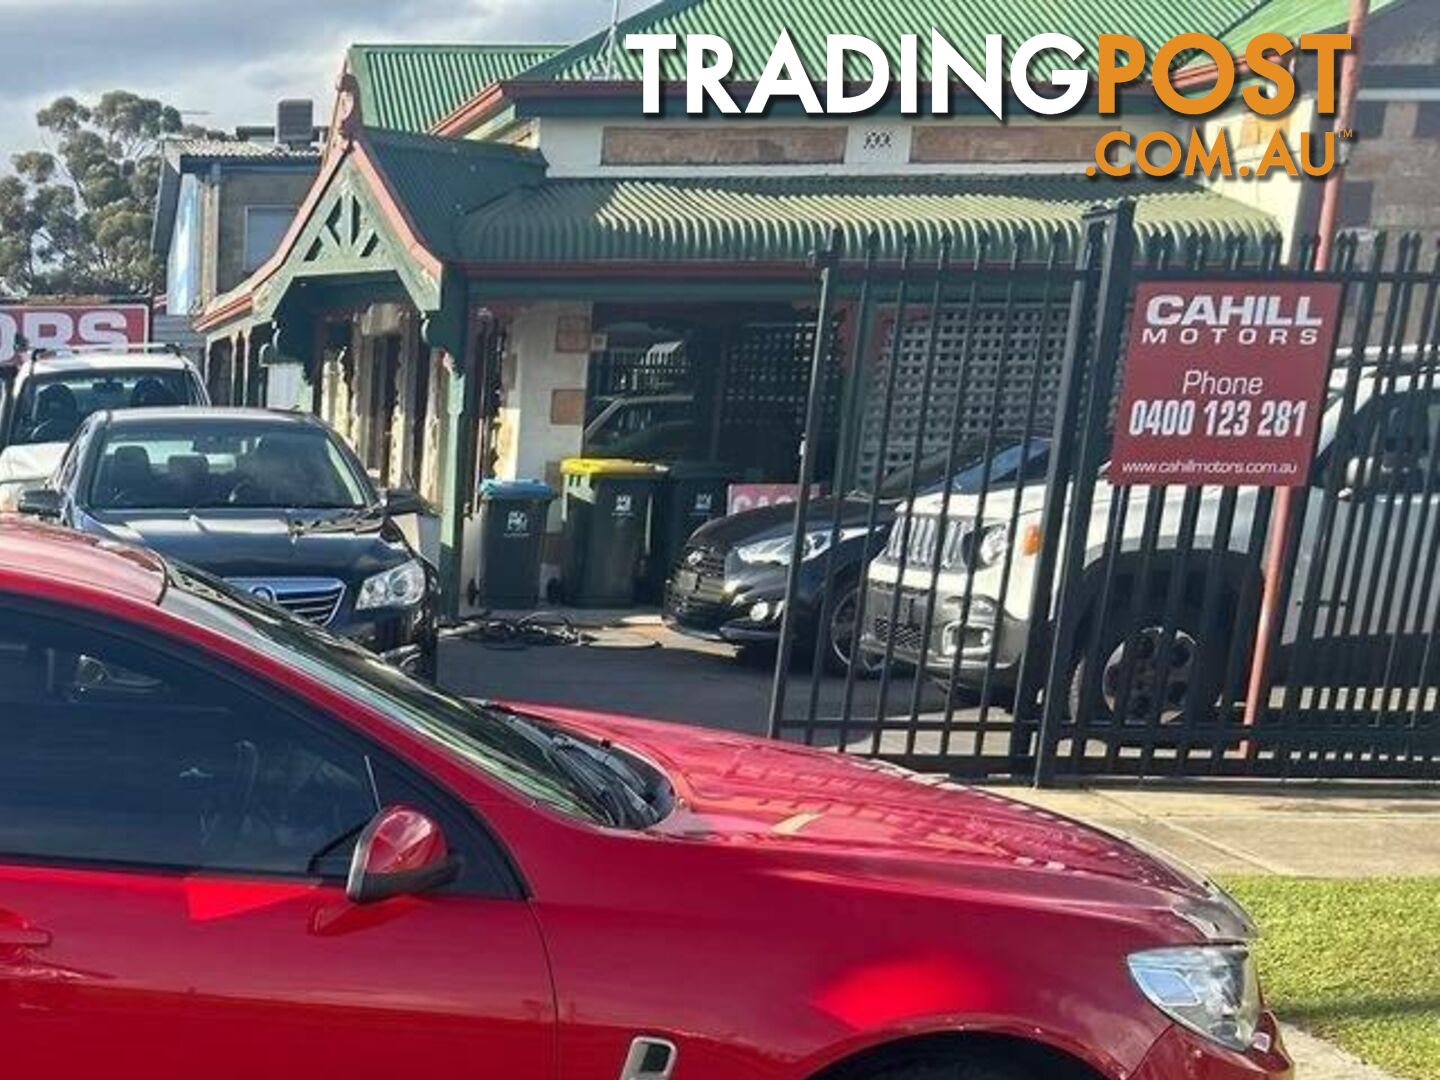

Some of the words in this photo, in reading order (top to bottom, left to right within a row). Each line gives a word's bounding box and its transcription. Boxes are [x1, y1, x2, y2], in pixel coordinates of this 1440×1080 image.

[1146, 294, 1323, 326] CAHILL
[1141, 328, 1319, 345] MOTORS
[1182, 370, 1264, 395] Phone
[1129, 400, 1195, 436] 0400
[1203, 400, 1251, 436] 123
[1257, 401, 1307, 437] 281
[1121, 460, 1298, 474] www.cahillmotors.com.au
